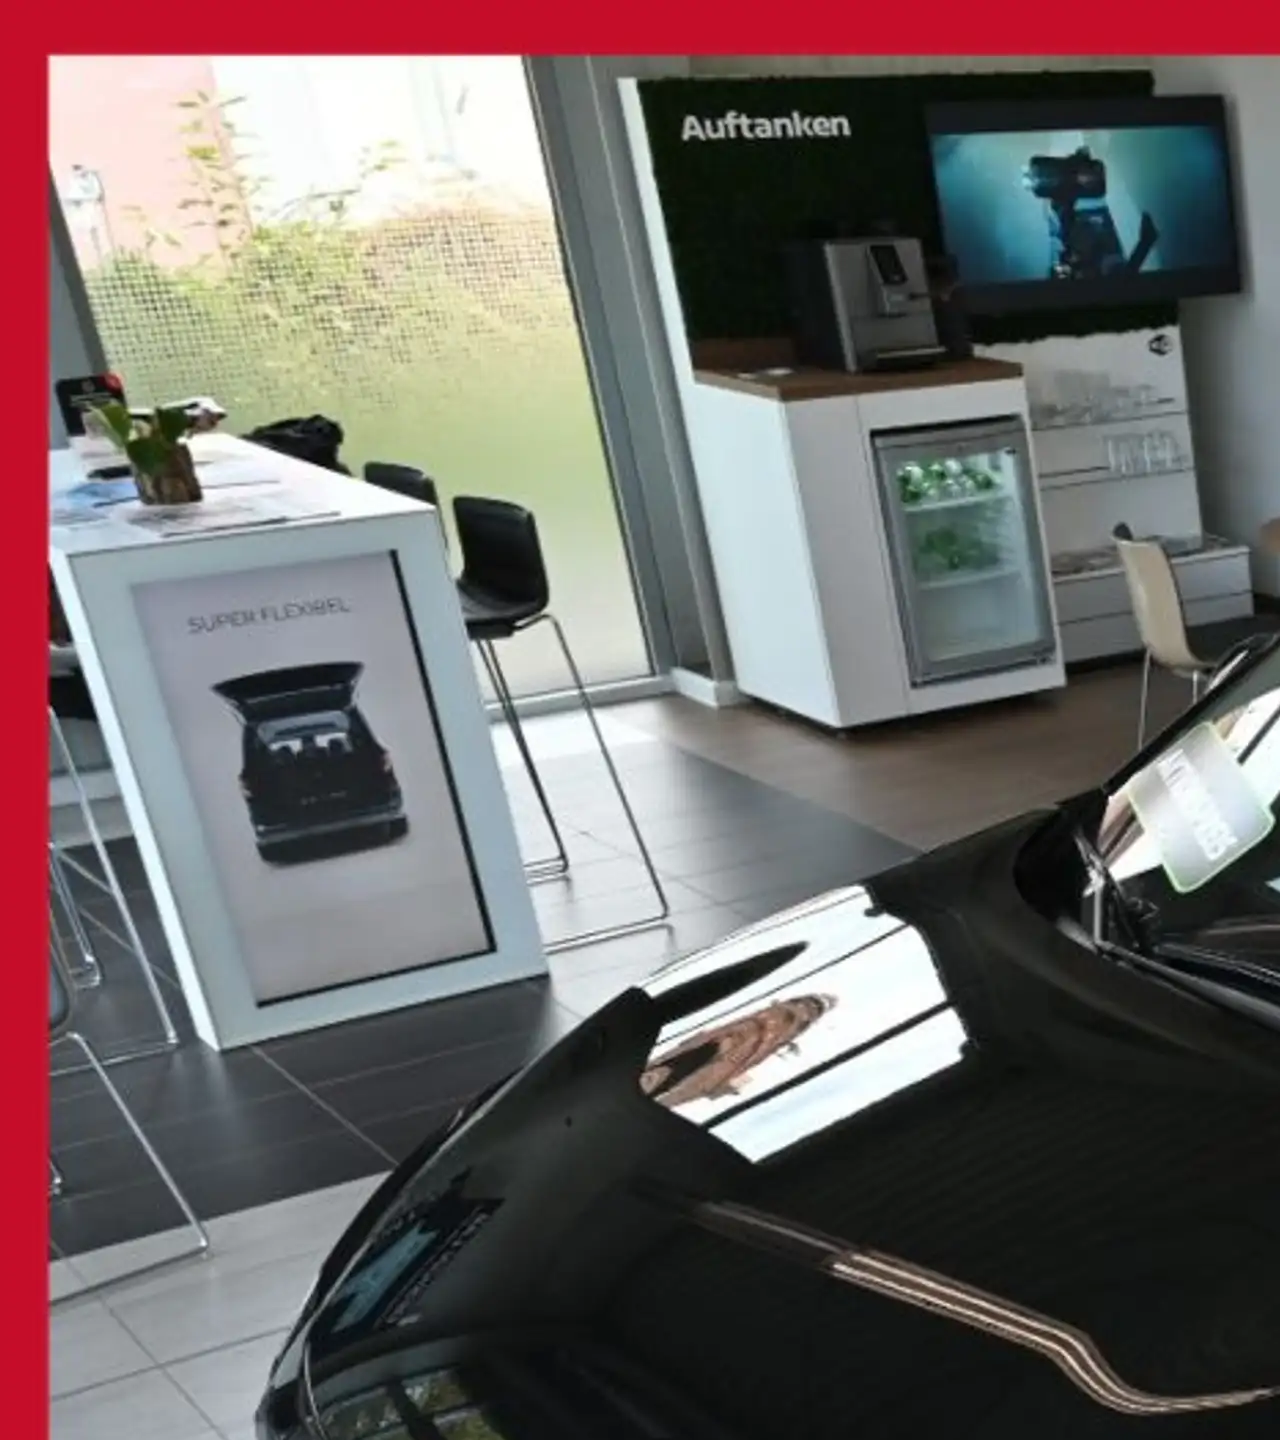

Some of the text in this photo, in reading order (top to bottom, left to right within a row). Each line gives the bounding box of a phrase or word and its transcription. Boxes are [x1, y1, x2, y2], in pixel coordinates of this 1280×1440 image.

[681, 109, 852, 142] Auftanken
[187, 596, 351, 635] SUPER FLEXIBEL
